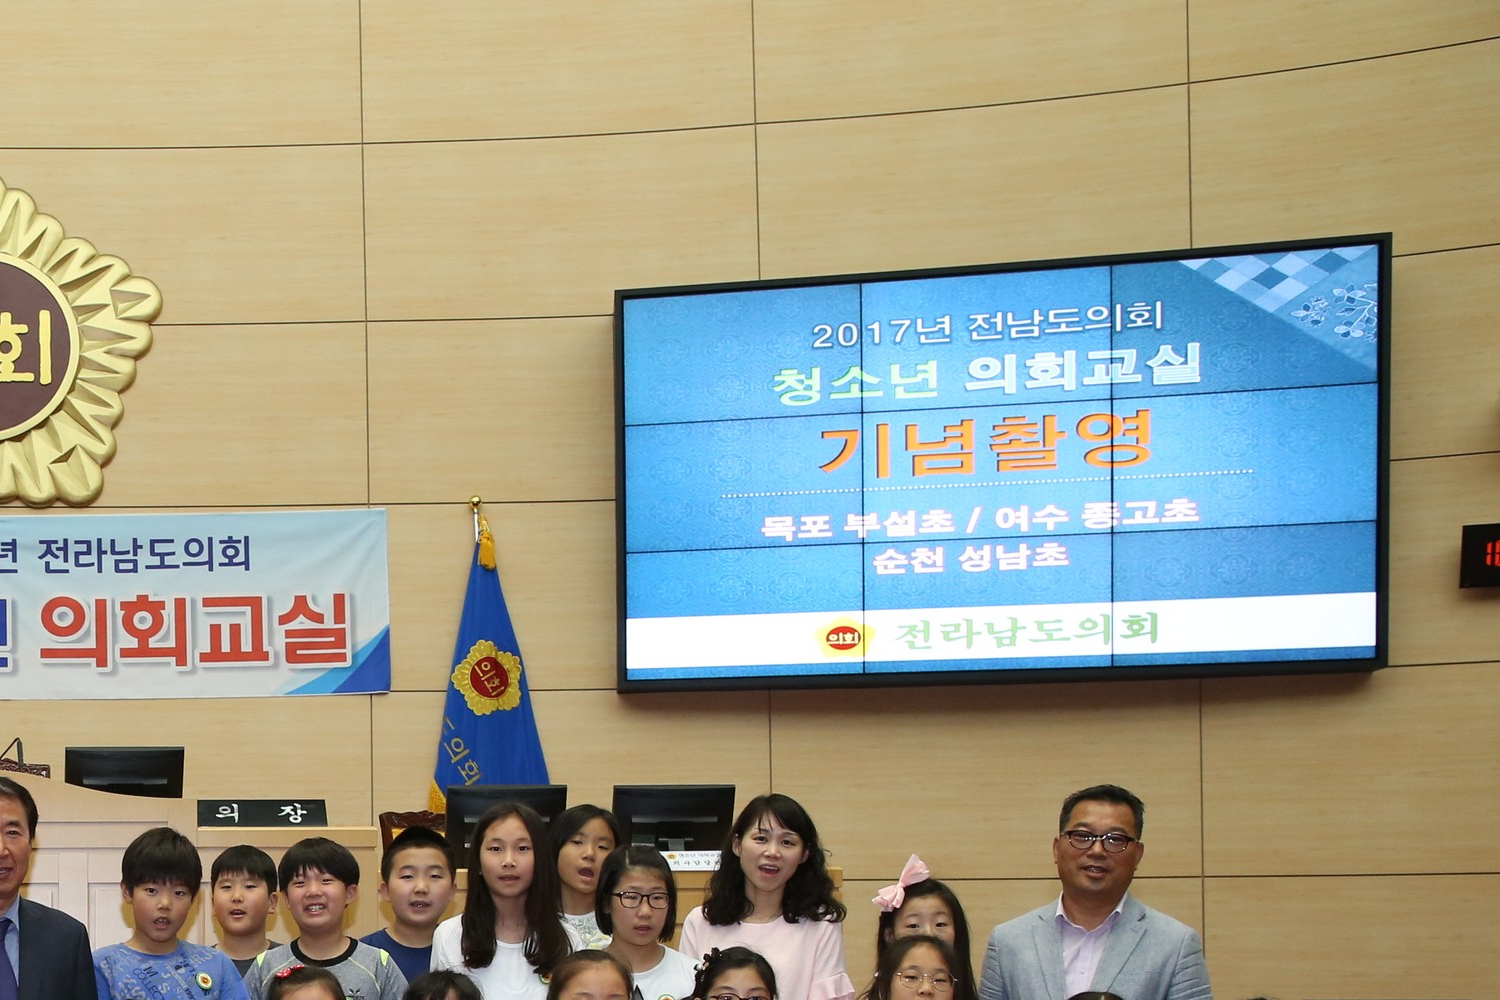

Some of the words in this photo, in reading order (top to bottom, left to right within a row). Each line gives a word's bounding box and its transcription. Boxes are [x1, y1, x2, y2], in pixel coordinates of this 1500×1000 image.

[812, 315, 952, 348] 2017년
[967, 300, 1163, 341] 전남도의회
[773, 359, 939, 406] 청소년
[964, 342, 1202, 395] 의회교실
[819, 408, 1153, 478] 기념촬영
[761, 515, 833, 542] 목포
[843, 509, 955, 539] 부설초
[994, 504, 1070, 532] 여수
[37, 535, 252, 574] 전라남도의회
[872, 545, 945, 575] 순천
[957, 542, 1071, 573] 성남초
[40, 592, 348, 669] 의회교실
[826, 630, 860, 646] 의회
[895, 611, 1159, 650] 전라남도의회
[474, 661, 505, 697] 의회
